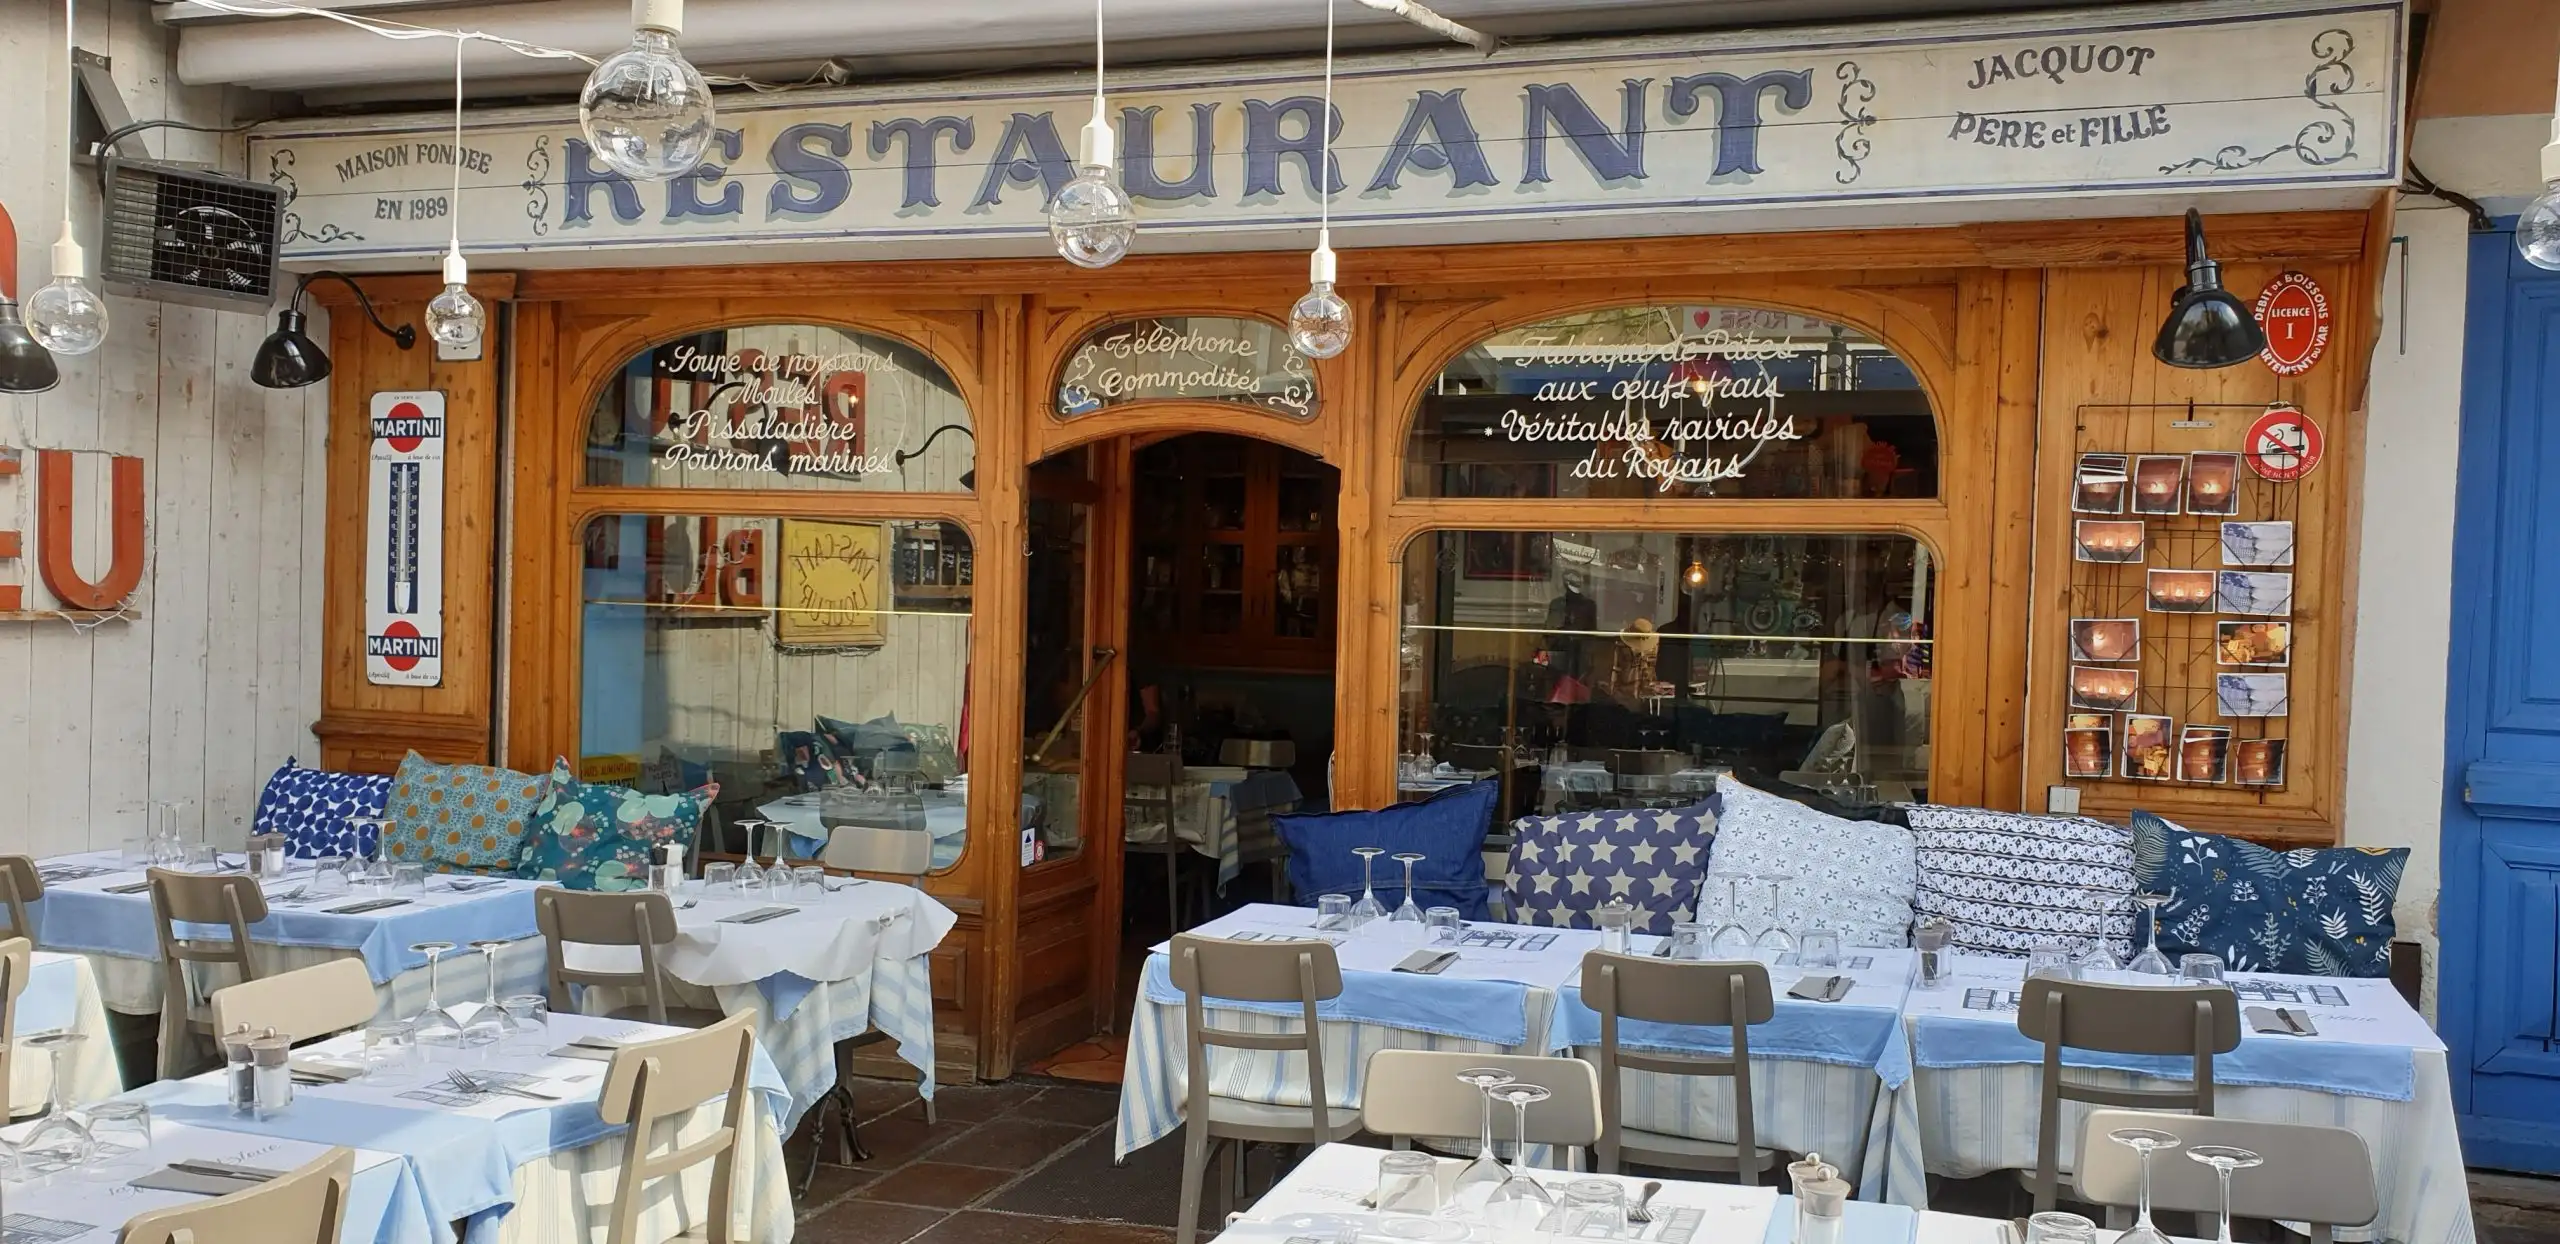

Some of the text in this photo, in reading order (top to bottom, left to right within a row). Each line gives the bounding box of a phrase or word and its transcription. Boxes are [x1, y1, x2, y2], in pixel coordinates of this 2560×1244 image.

[1967, 44, 2155, 89] JACQUOT
[1948, 104, 2171, 149] PERE et FILLE
[335, 143, 493, 183] MAISON FONDEE
[561, 67, 1814, 228] RESTAURANT
[374, 196, 448, 221] EN 1989
[2254, 273, 2329, 321] DEBIT DE BOISSONS
[2271, 307, 2310, 318] LICENCE
[1104, 326, 1258, 359] Téléphone
[1515, 334, 1656, 371] Fabrique
[1661, 333, 1697, 362] de
[2260, 325, 2329, 375] ARTEMENT DU VAR
[669, 345, 898, 379] Soupe de poissons
[728, 376, 819, 405] Moules
[1099, 364, 1261, 397] Commodités
[1533, 377, 1598, 402] aux
[1701, 373, 1785, 408] frais
[373, 419, 440, 437] MARTINI
[683, 409, 856, 440] Pissaladière
[1501, 407, 1802, 443] Véritables ravioles
[662, 443, 893, 474] Poivrons marinés
[1571, 446, 1746, 493] du Royans
[369, 637, 437, 656] MARTINI
